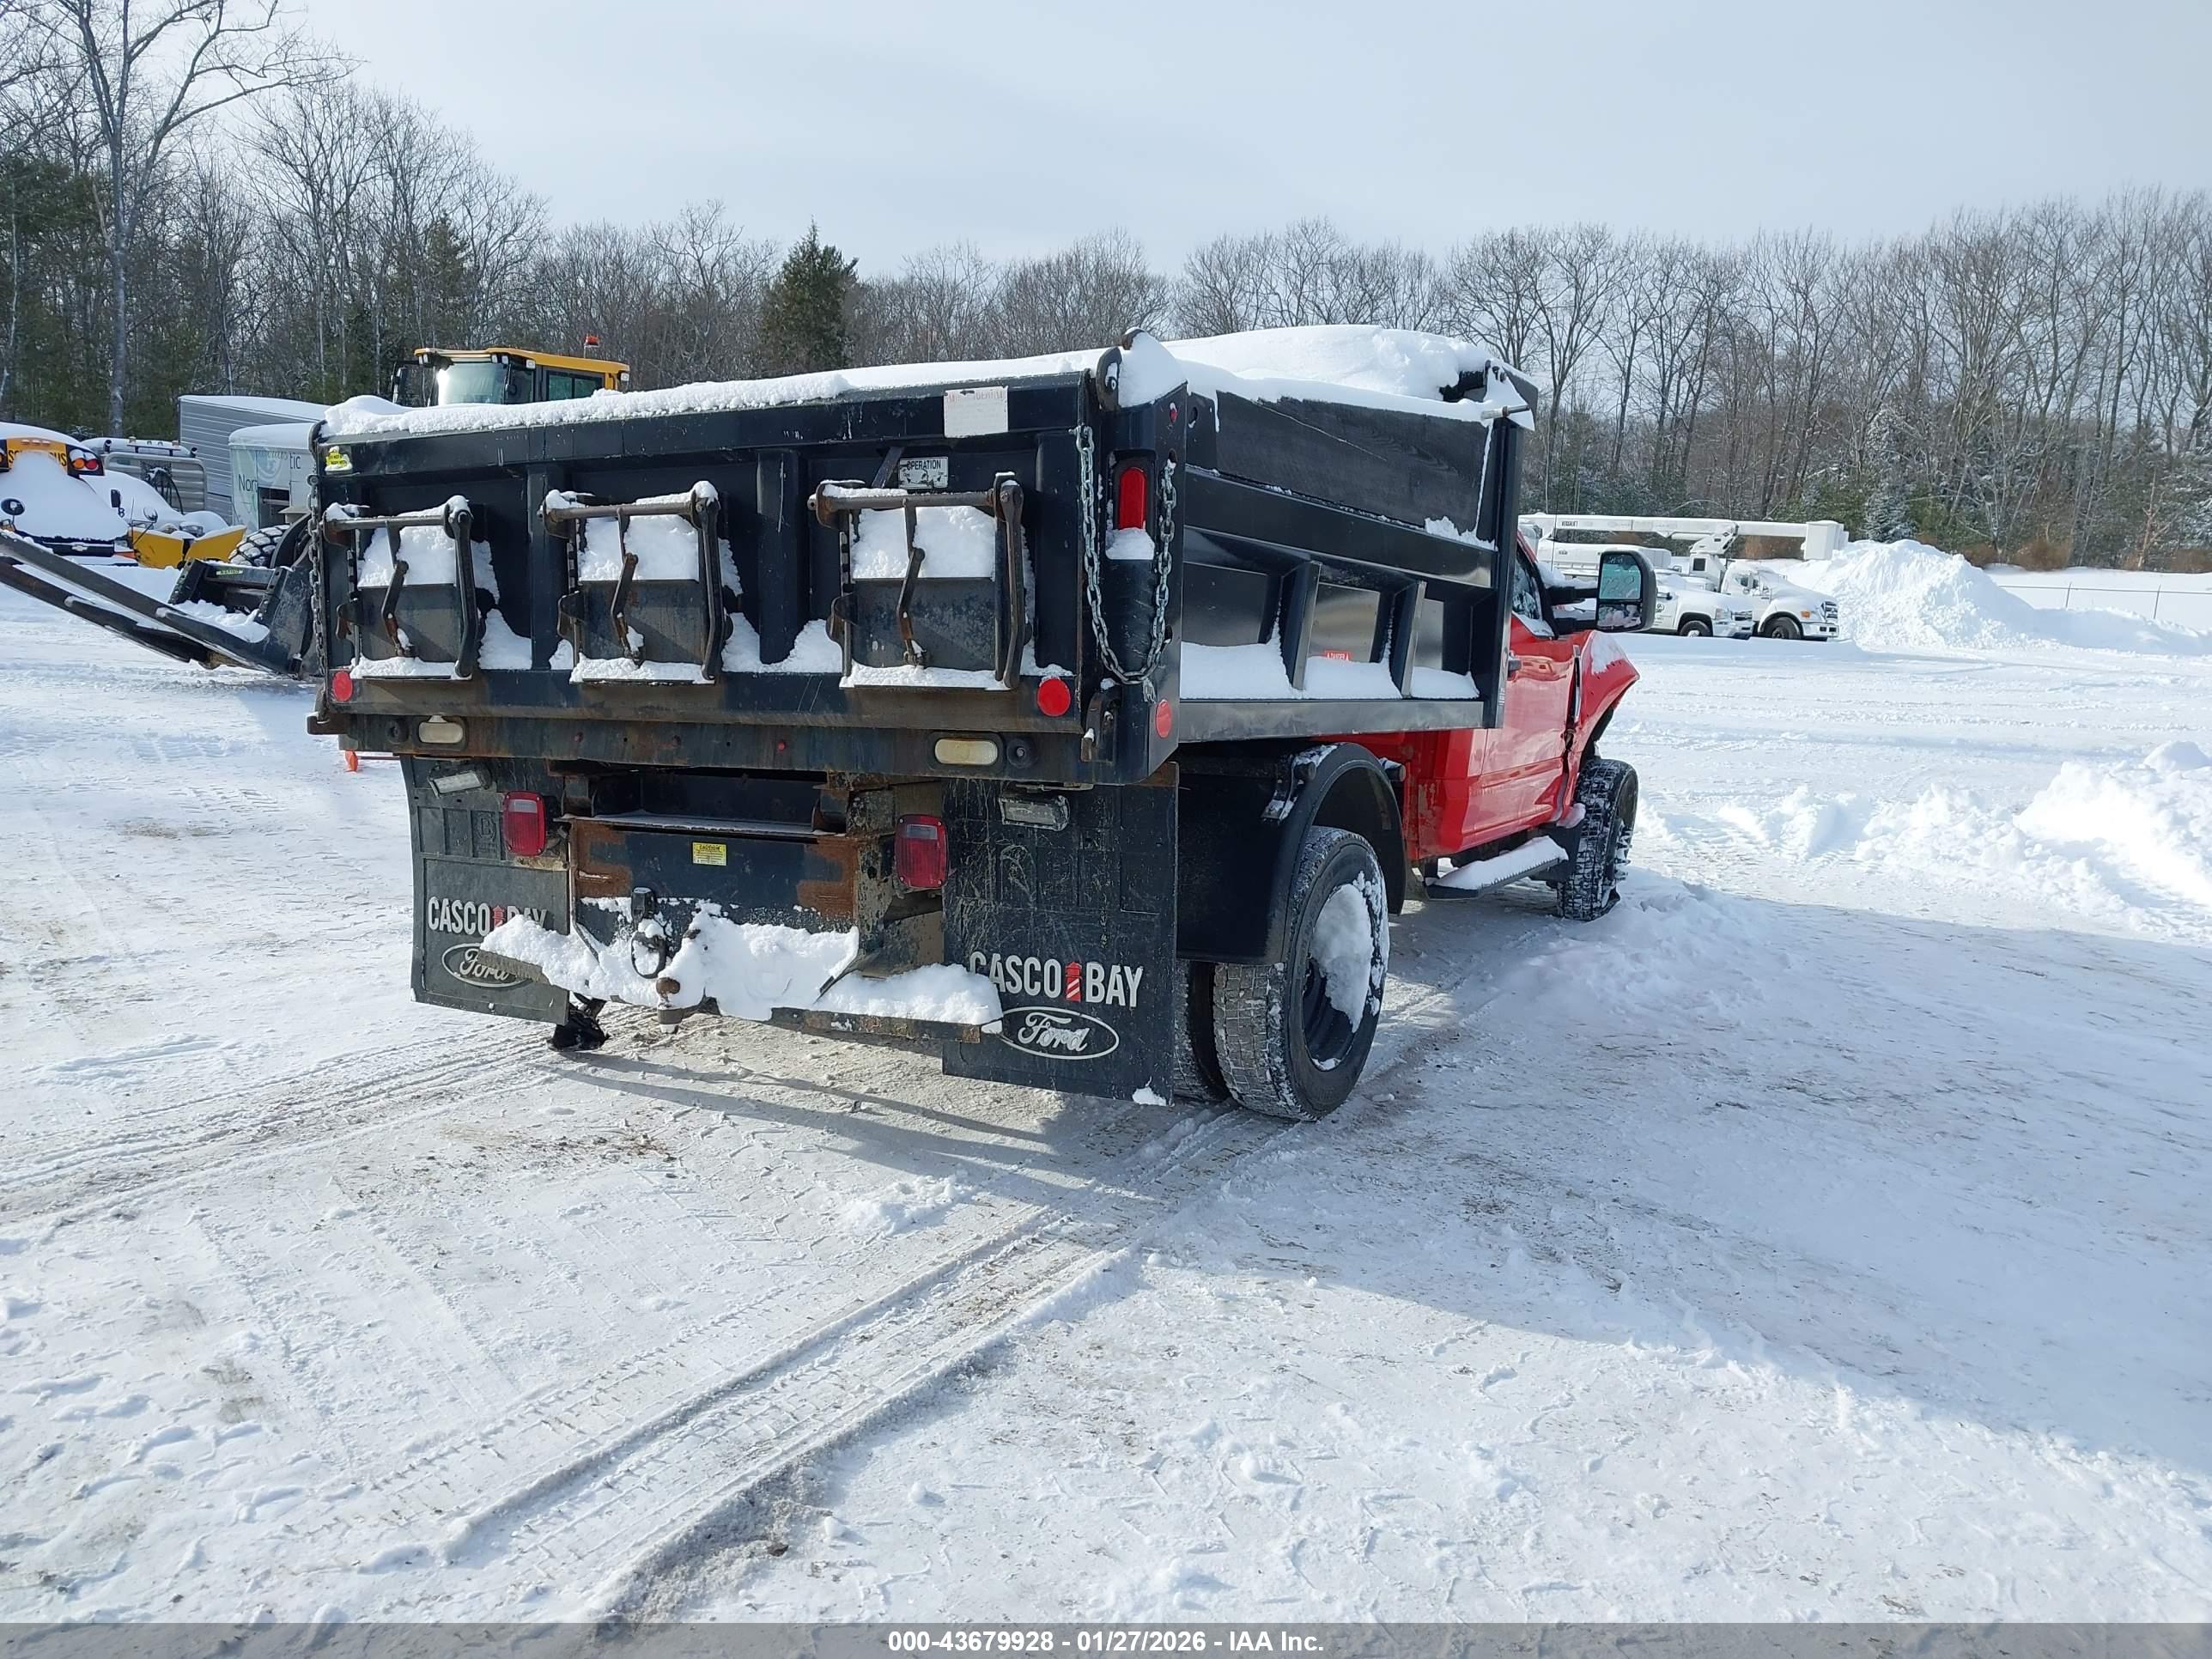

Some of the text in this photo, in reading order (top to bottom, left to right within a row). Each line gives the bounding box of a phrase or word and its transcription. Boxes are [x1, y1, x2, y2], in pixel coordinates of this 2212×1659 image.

[906, 459, 941, 471] OPERATION
[428, 896, 491, 938] CASCO
[969, 951, 1144, 1008] CASCO BAY
[1018, 1012, 1091, 1052] Ford
